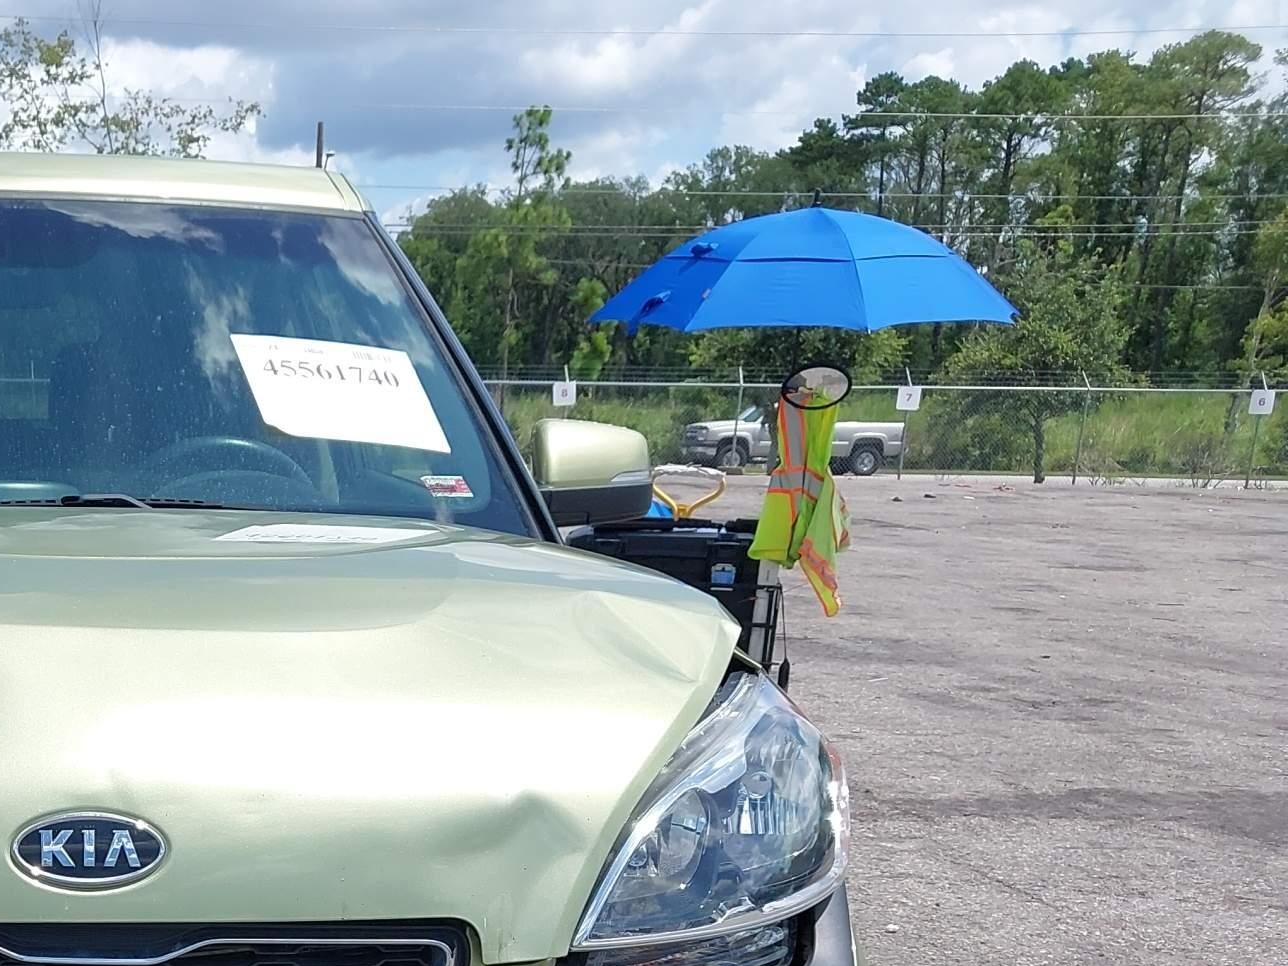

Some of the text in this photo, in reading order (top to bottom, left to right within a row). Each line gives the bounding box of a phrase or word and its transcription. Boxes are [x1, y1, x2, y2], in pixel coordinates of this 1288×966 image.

[263, 359, 400, 387] 45561740
[906, 393, 913, 402] 7
[1258, 397, 1266, 407] 6
[39, 829, 141, 867] KIA
